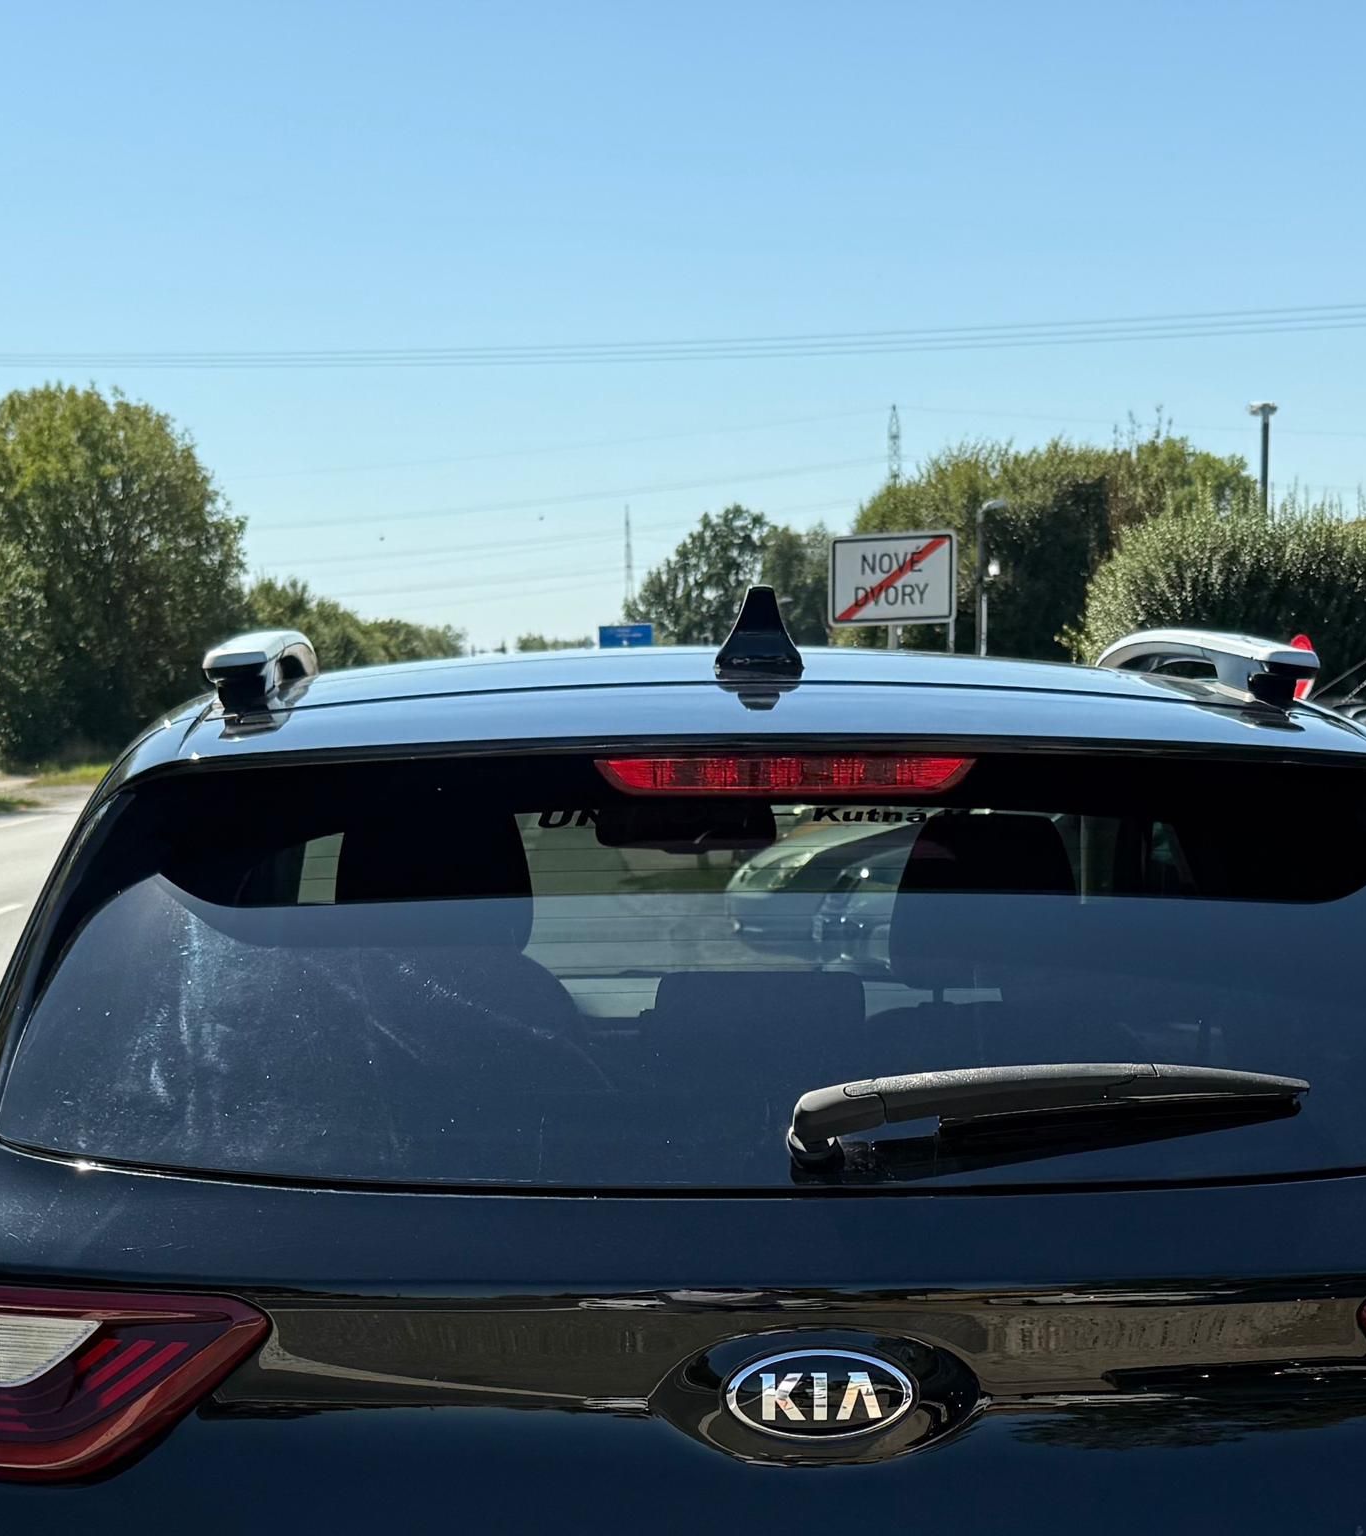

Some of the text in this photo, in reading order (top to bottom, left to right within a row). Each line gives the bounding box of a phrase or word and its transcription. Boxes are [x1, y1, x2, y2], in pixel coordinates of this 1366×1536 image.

[860, 545, 923, 575] NOVÉ
[854, 583, 929, 608] DVORY
[813, 806, 927, 823] Kutná
[759, 1371, 883, 1421] KIA
